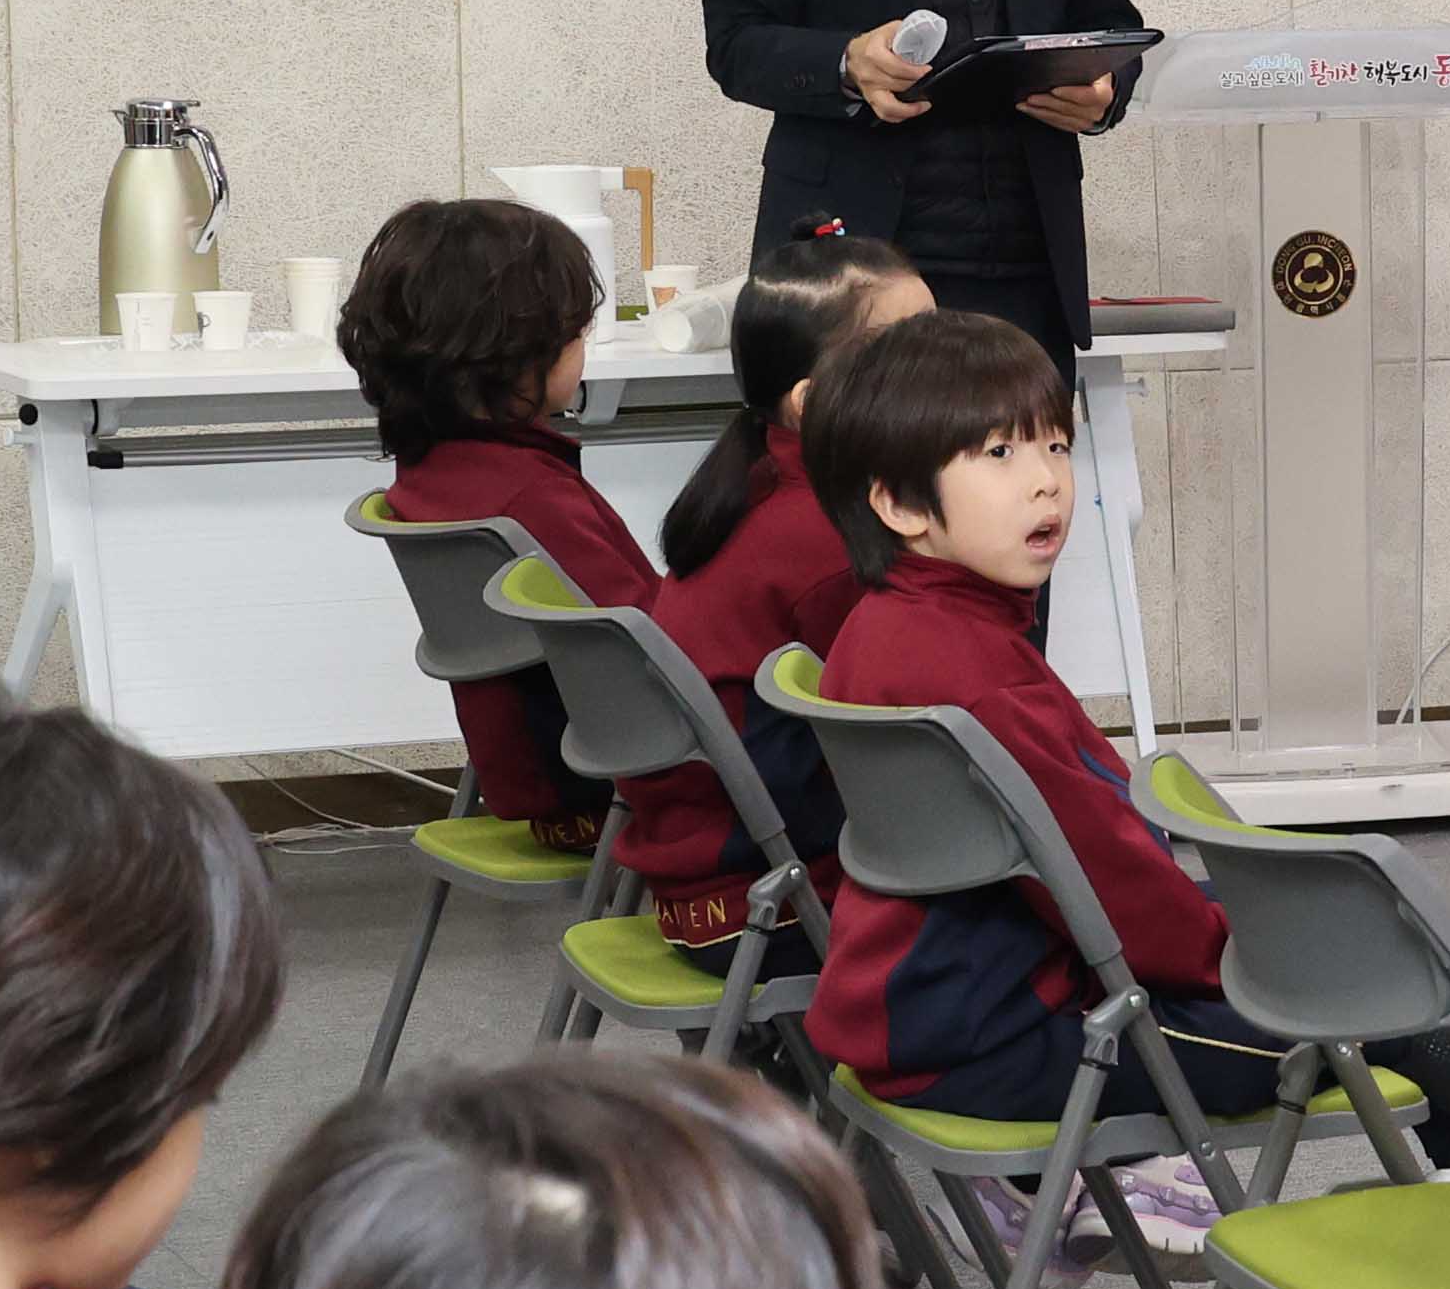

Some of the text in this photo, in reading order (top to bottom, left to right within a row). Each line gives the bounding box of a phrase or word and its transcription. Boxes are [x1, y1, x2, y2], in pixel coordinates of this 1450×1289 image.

[1220, 71, 1245, 88] 살고
[1248, 71, 1272, 88] 싶은
[1276, 70, 1304, 87] 도시!
[1309, 59, 1358, 87] 활기찬
